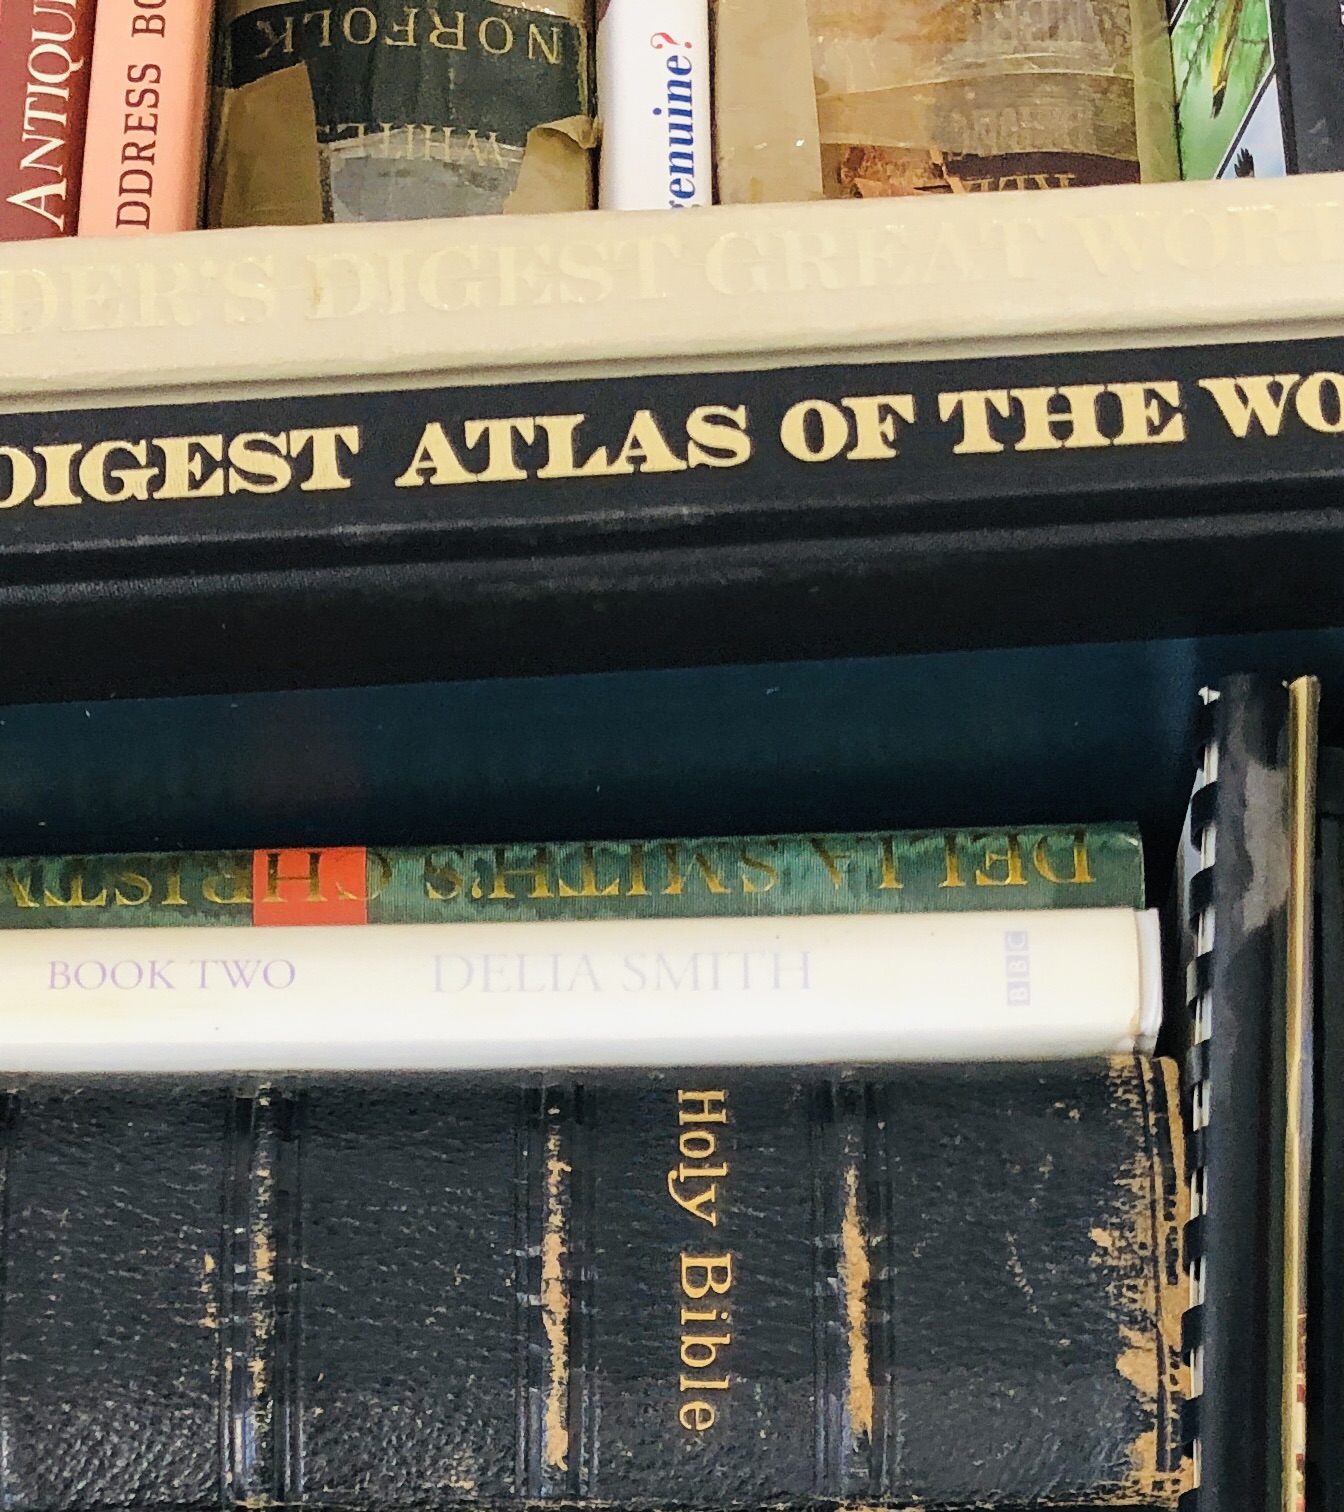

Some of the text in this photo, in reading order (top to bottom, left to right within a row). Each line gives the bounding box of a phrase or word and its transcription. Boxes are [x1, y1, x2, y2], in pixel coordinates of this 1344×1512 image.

[255, 5, 562, 65] NORFOLK
[6, 0, 84, 232] ANTIQU
[115, 63, 161, 230] DDRESS
[304, 233, 681, 322] DIGEST
[703, 213, 1064, 300] GREAT
[394, 404, 752, 488] ATLAS
[779, 394, 916, 464] OF
[937, 380, 1187, 455] THE
[425, 839, 778, 899] SMITH'S
[811, 829, 1097, 891] DELIA
[47, 959, 177, 992] BOOK
[189, 958, 298, 991] TWO
[431, 949, 813, 995] DELIA SMITH
[1004, 930, 1031, 1006] BBC
[667, 1088, 735, 1432] Holy Bible
